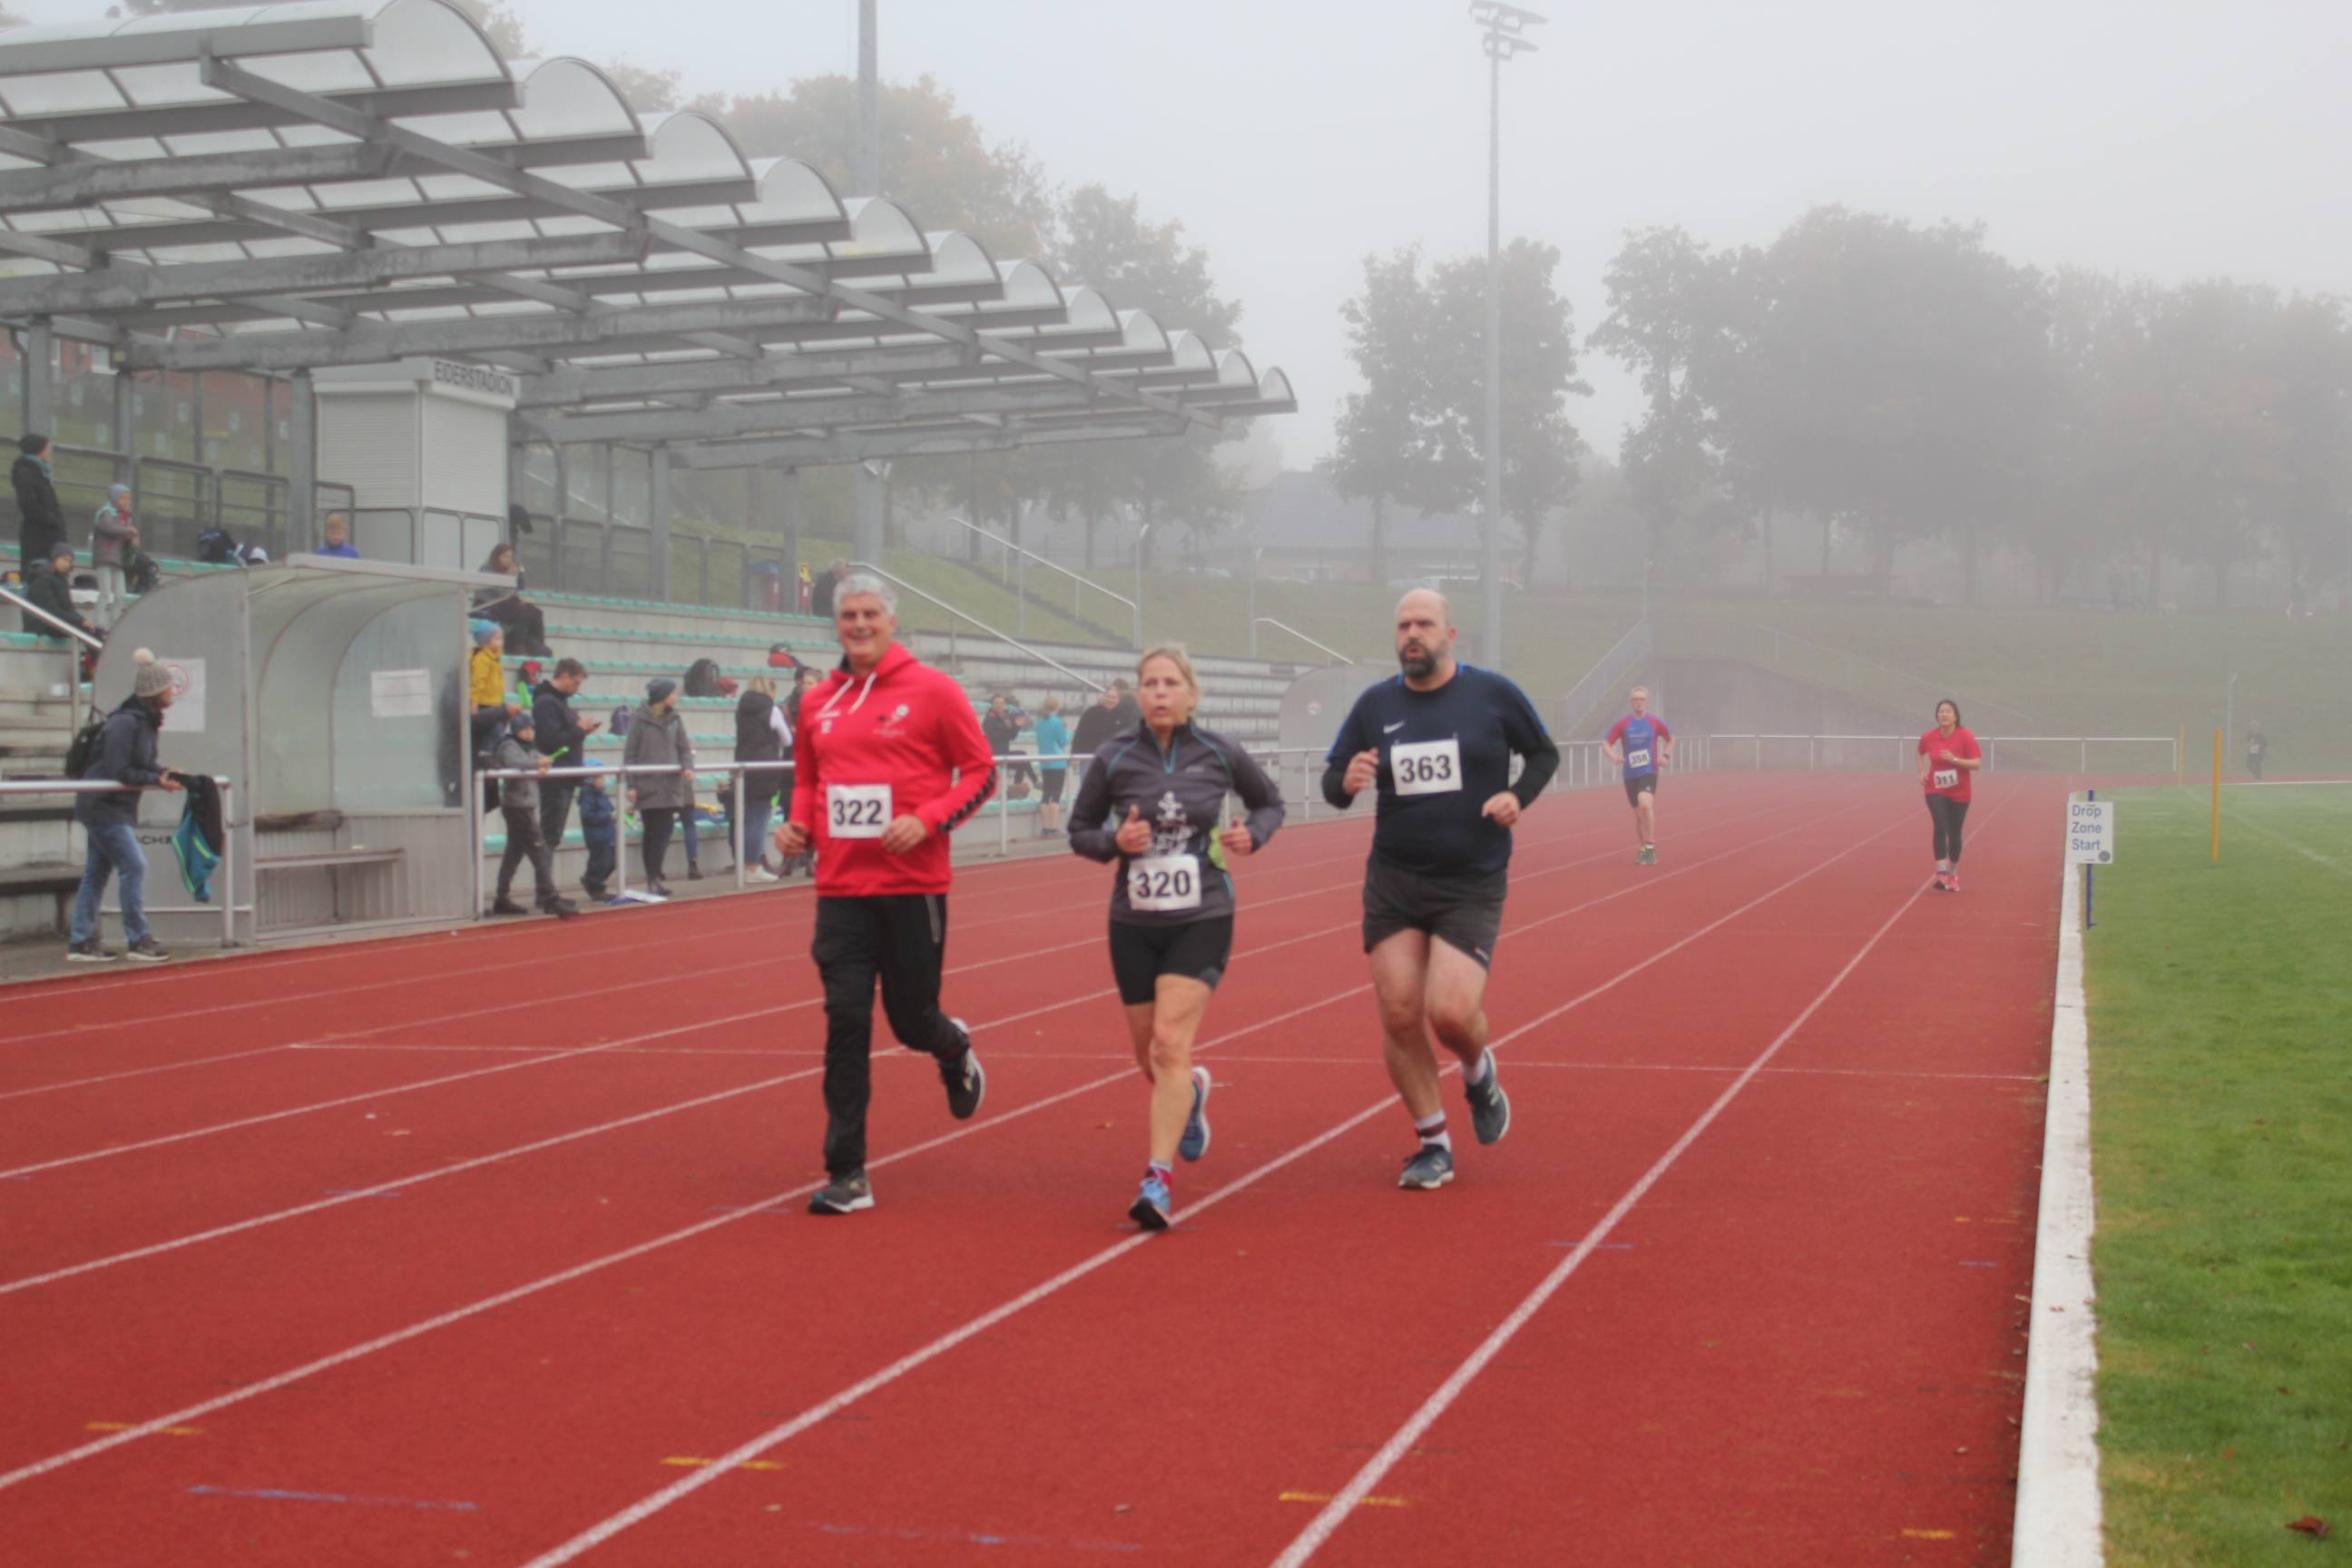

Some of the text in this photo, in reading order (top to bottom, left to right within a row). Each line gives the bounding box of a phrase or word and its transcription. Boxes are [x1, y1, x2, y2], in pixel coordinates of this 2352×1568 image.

[436, 360, 514, 396] EIDERSTADION
[1399, 754, 1452, 783] 363
[1936, 774, 1955, 785] 311
[832, 799, 883, 826] 322
[2072, 805, 2102, 819] Drop
[2072, 821, 2102, 833] Zone
[2072, 838, 2101, 850] Start
[1136, 869, 1191, 898] 320
